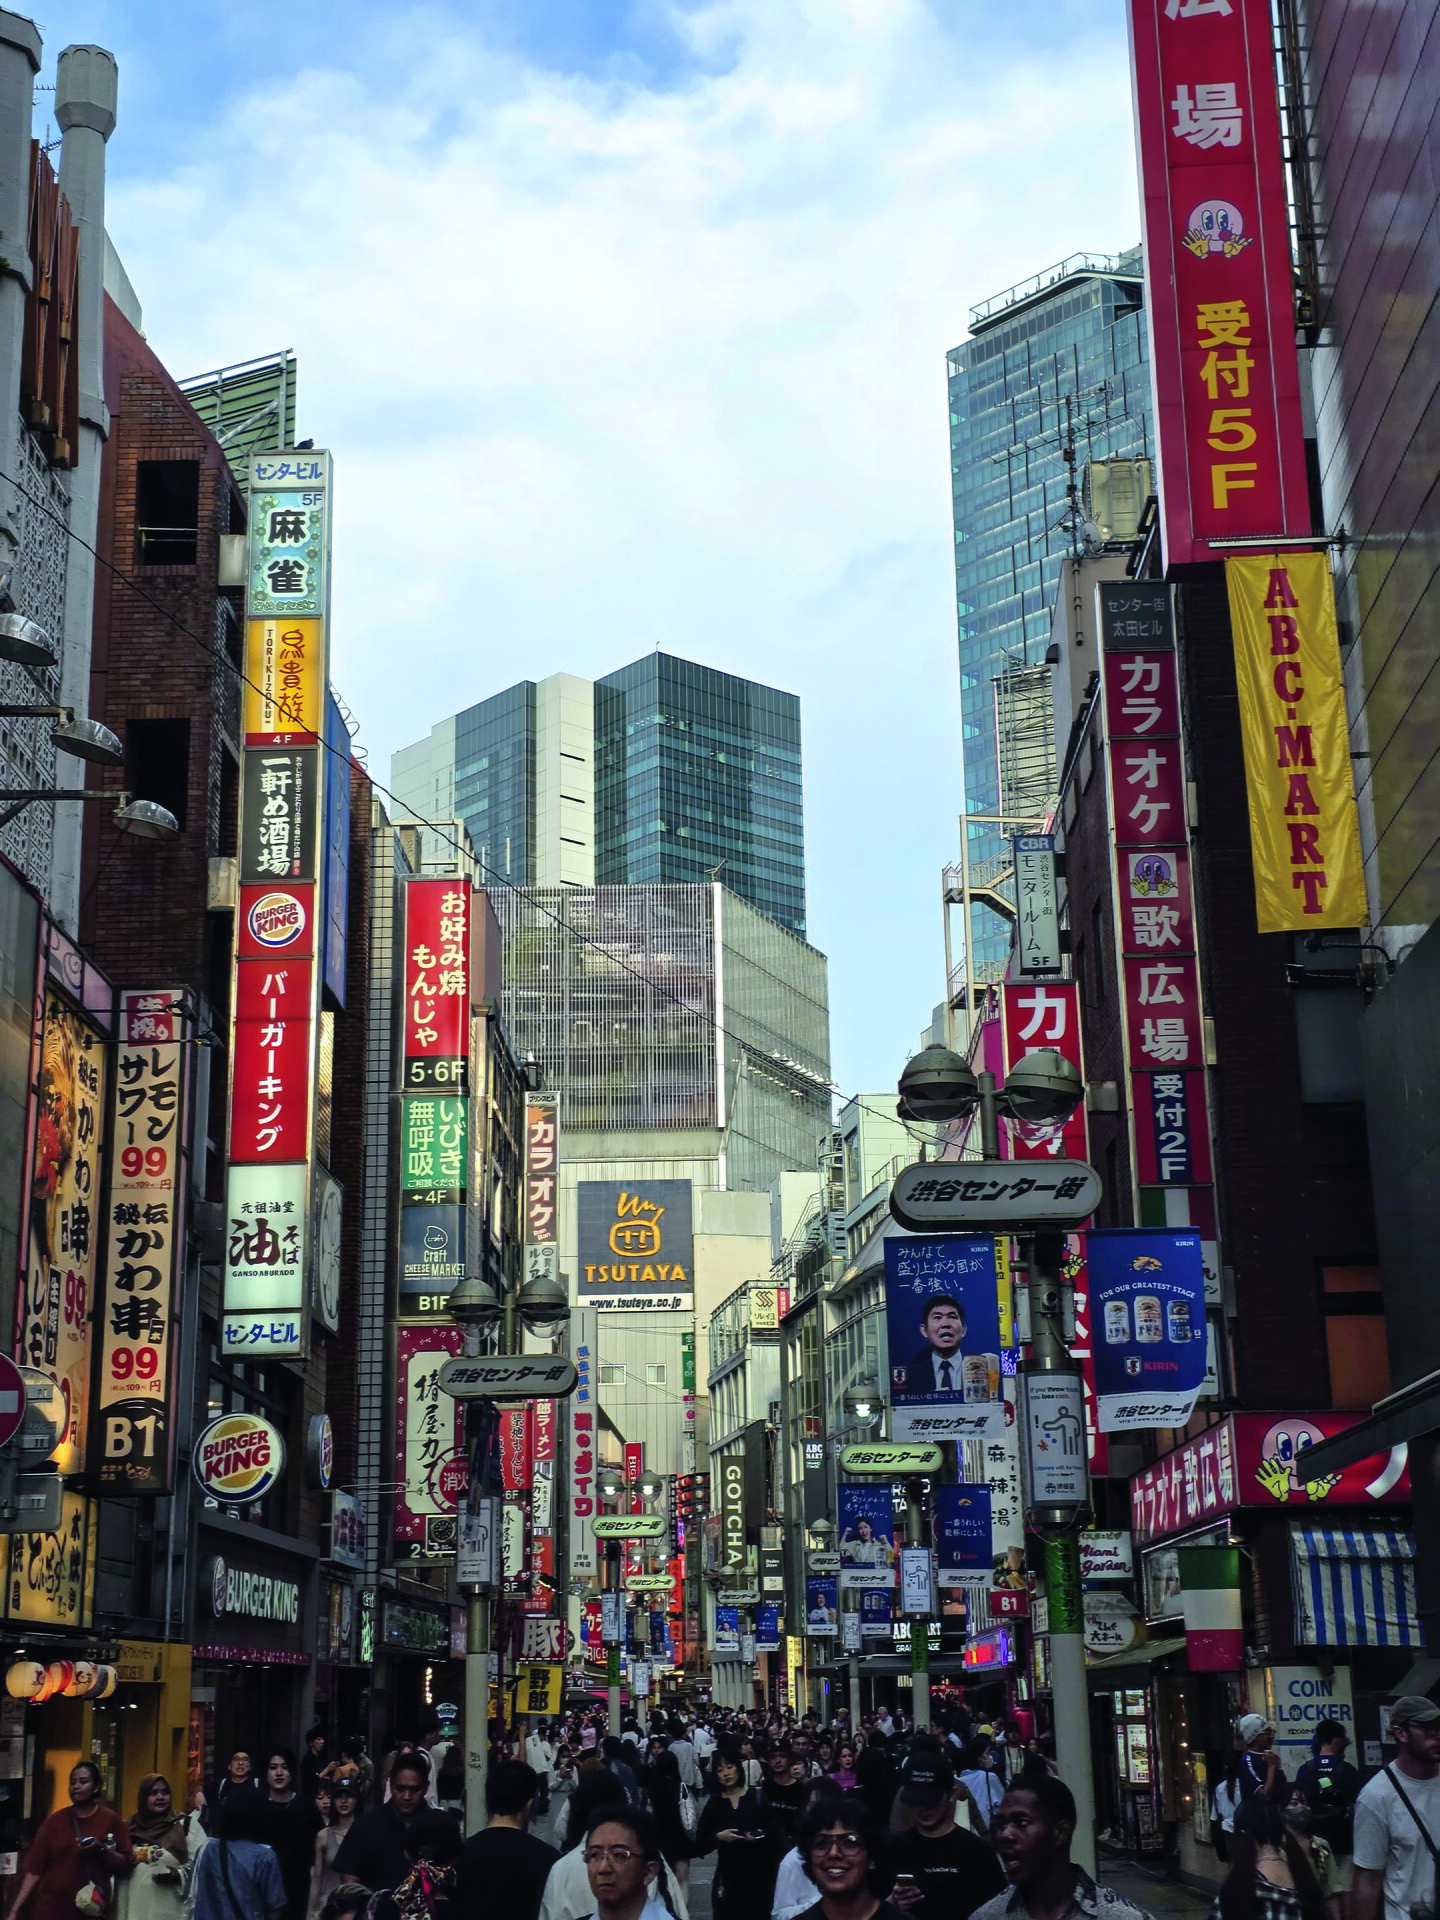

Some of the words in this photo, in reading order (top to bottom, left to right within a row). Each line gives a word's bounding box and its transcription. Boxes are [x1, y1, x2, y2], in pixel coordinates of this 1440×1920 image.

[1196, 300, 1257, 509] 受付5F
[256, 461, 323, 480] センタービル
[302, 494, 322, 506] 5F
[267, 509, 306, 594] 麻雀
[1107, 598, 1165, 612] センター街
[1113, 620, 1163, 637] 太田ビル
[279, 629, 305, 723] 鳥貴族
[1120, 656, 1171, 833] カラオケ
[256, 756, 292, 877] 一軒め酒場
[1018, 837, 1049, 850] CBR
[1040, 855, 1053, 915] 渋谷センター街
[255, 903, 297, 922] BURGER
[1021, 855, 1042, 951] モニタールーム
[256, 912, 299, 936] KING
[439, 891, 466, 995] お好み焼
[1032, 957, 1050, 966] 5F
[411, 944, 438, 1047] もんじゃ
[1131, 905, 1189, 1062] 歌広場
[256, 971, 288, 1151] バーガーキング
[118, 1054, 148, 1145] サワー
[148, 1047, 176, 1142] レモン
[408, 1102, 434, 1177] 無呼吸
[439, 1101, 466, 1175] いびき
[1153, 1074, 1187, 1180] 受付2F
[121, 1146, 167, 1177] 99
[530, 1121, 554, 1227] カラオケ
[425, 1190, 447, 1204] 4F
[905, 1176, 1089, 1203] 渋谷センター街
[241, 1201, 295, 1213] 元祖油堂
[404, 1264, 430, 1274] CHEESE
[431, 1263, 465, 1277] MARKET
[424, 1250, 447, 1263] Craft
[897, 1258, 984, 1276] 盛り上がる国が
[584, 1263, 686, 1282] TSUTAYA
[418, 1296, 450, 1310] B1F
[590, 1296, 681, 1309] www.tsutaya.co.jp
[1099, 1289, 1114, 1301] FOR
[1114, 1284, 1131, 1293] OUR
[1132, 1282, 1172, 1291] GREATEST
[1172, 1285, 1196, 1299] STAGE
[225, 1323, 299, 1344] センタービル
[111, 1347, 158, 1380] 99
[447, 1365, 568, 1384] 渋谷センター街
[1144, 1362, 1178, 1371] KIRIN
[105, 1415, 156, 1457] B1
[537, 1398, 551, 1458] 郎ラーメン
[908, 1416, 990, 1430] 渋谷センター街
[203, 1430, 269, 1461] BURGER
[806, 1444, 823, 1452] ABC
[846, 1451, 937, 1464] 渋谷センター街
[203, 1445, 271, 1484] KING
[1133, 1424, 1233, 1542] カラオケ歌広場
[595, 1520, 663, 1531] 渋谷センター街
[726, 1465, 743, 1564] GOTCHA
[226, 1569, 272, 1619] BURGER
[273, 1580, 299, 1623] KING
[1001, 1597, 1017, 1611] B1
[522, 1620, 561, 1657] 豚
[1289, 1680, 1333, 1697] COIN
[1279, 1704, 1352, 1721] LOCKER
